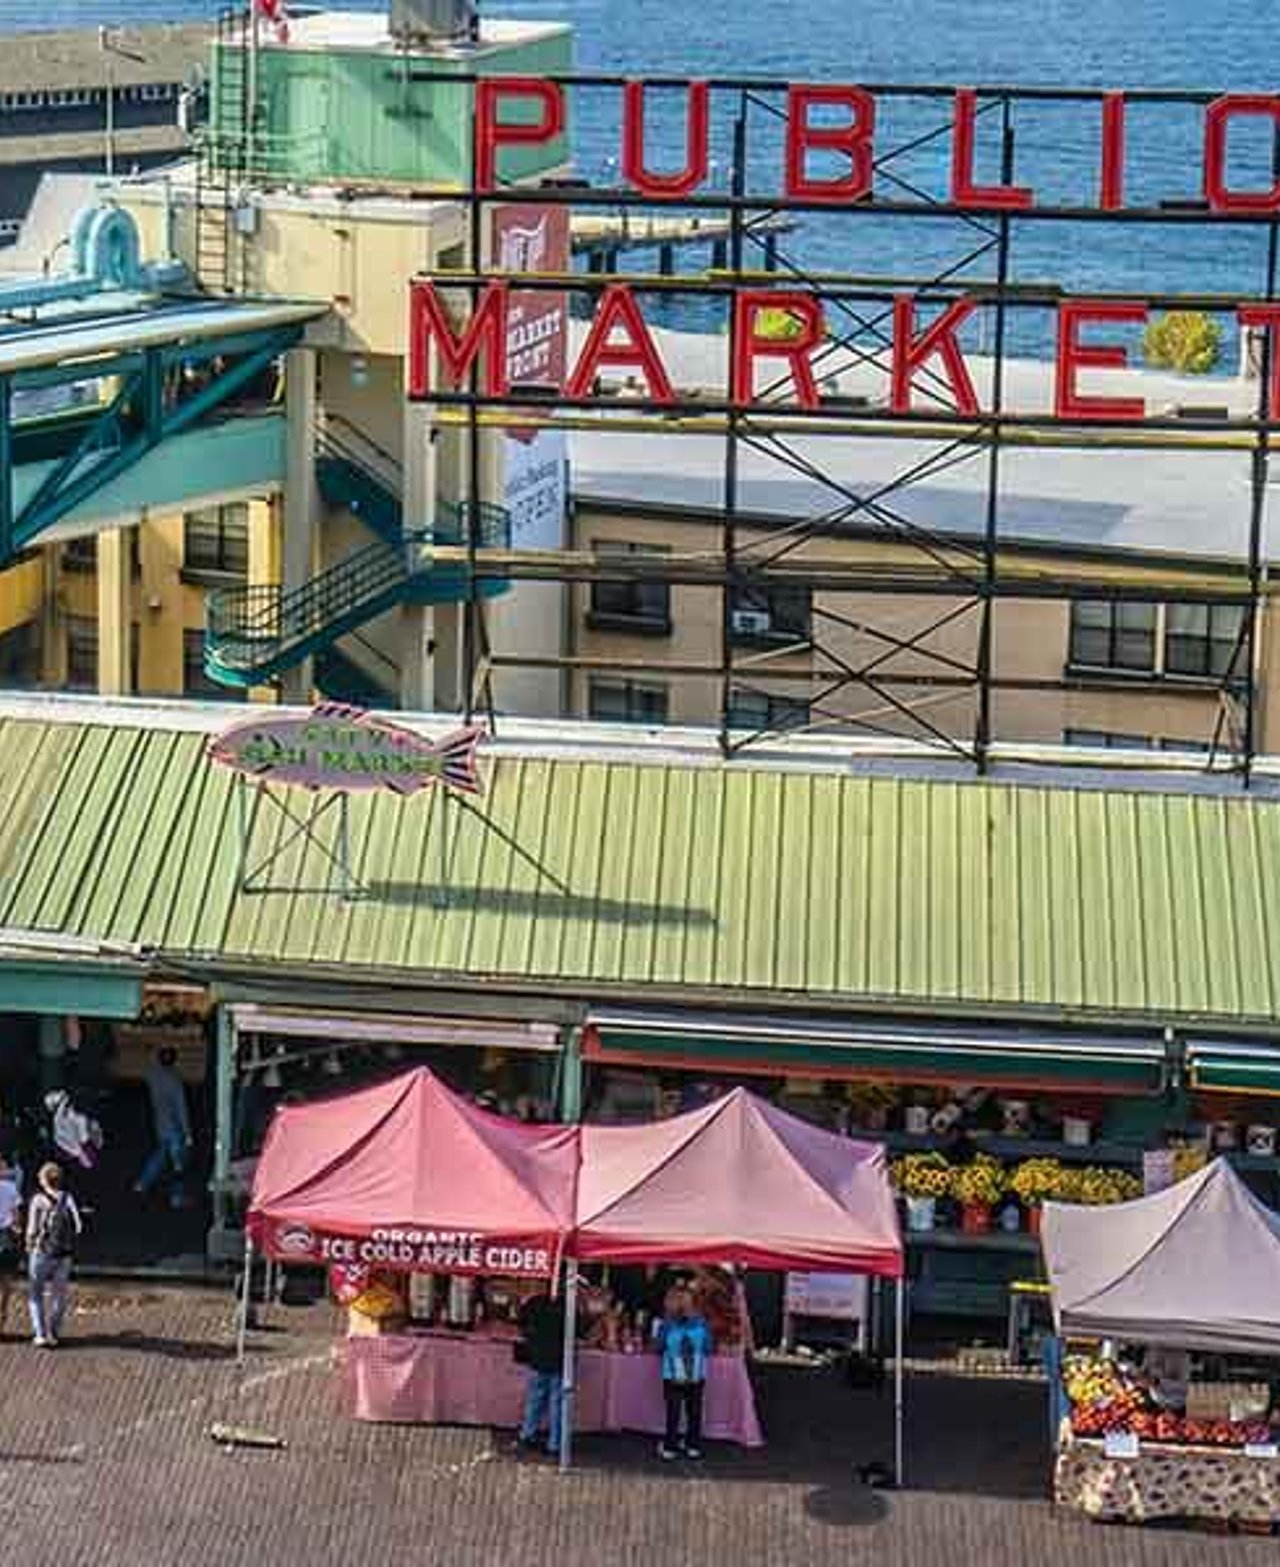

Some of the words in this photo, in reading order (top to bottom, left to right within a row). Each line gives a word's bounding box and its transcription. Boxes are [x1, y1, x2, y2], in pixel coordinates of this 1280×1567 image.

[372, 1228, 483, 1243] ORGANIC
[321, 1238, 356, 1260] ICE
[360, 1241, 413, 1262] COLD
[417, 1244, 482, 1267] APPLE
[485, 1247, 549, 1270] CIDER
